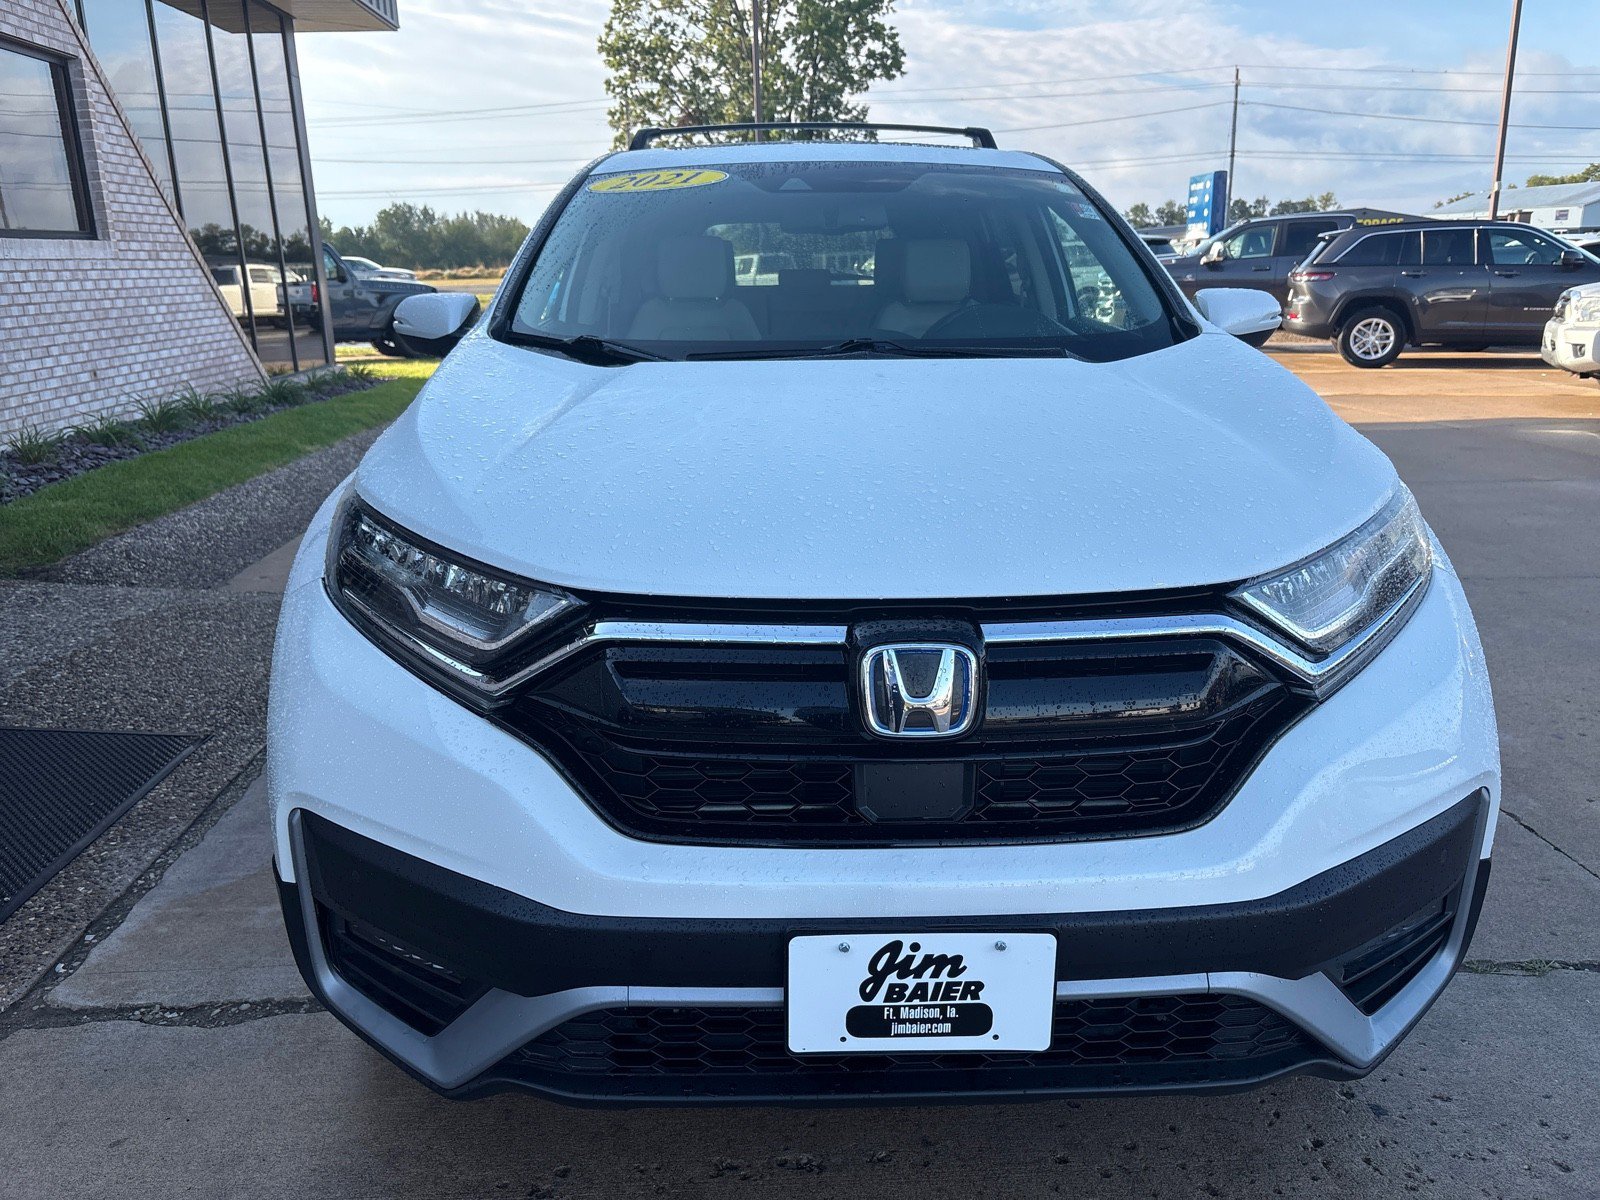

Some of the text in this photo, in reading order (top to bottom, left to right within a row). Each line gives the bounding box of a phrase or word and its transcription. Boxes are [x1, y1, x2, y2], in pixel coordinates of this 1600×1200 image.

[607, 171, 702, 190] 2021
[1356, 217, 1404, 226] TORAGE
[859, 939, 968, 1003] Jim
[883, 980, 985, 1004] BAIER
[883, 1006, 897, 1020] Ft.
[900, 1006, 943, 1020] Madison,
[890, 1021, 952, 1037] jimbaier.com
